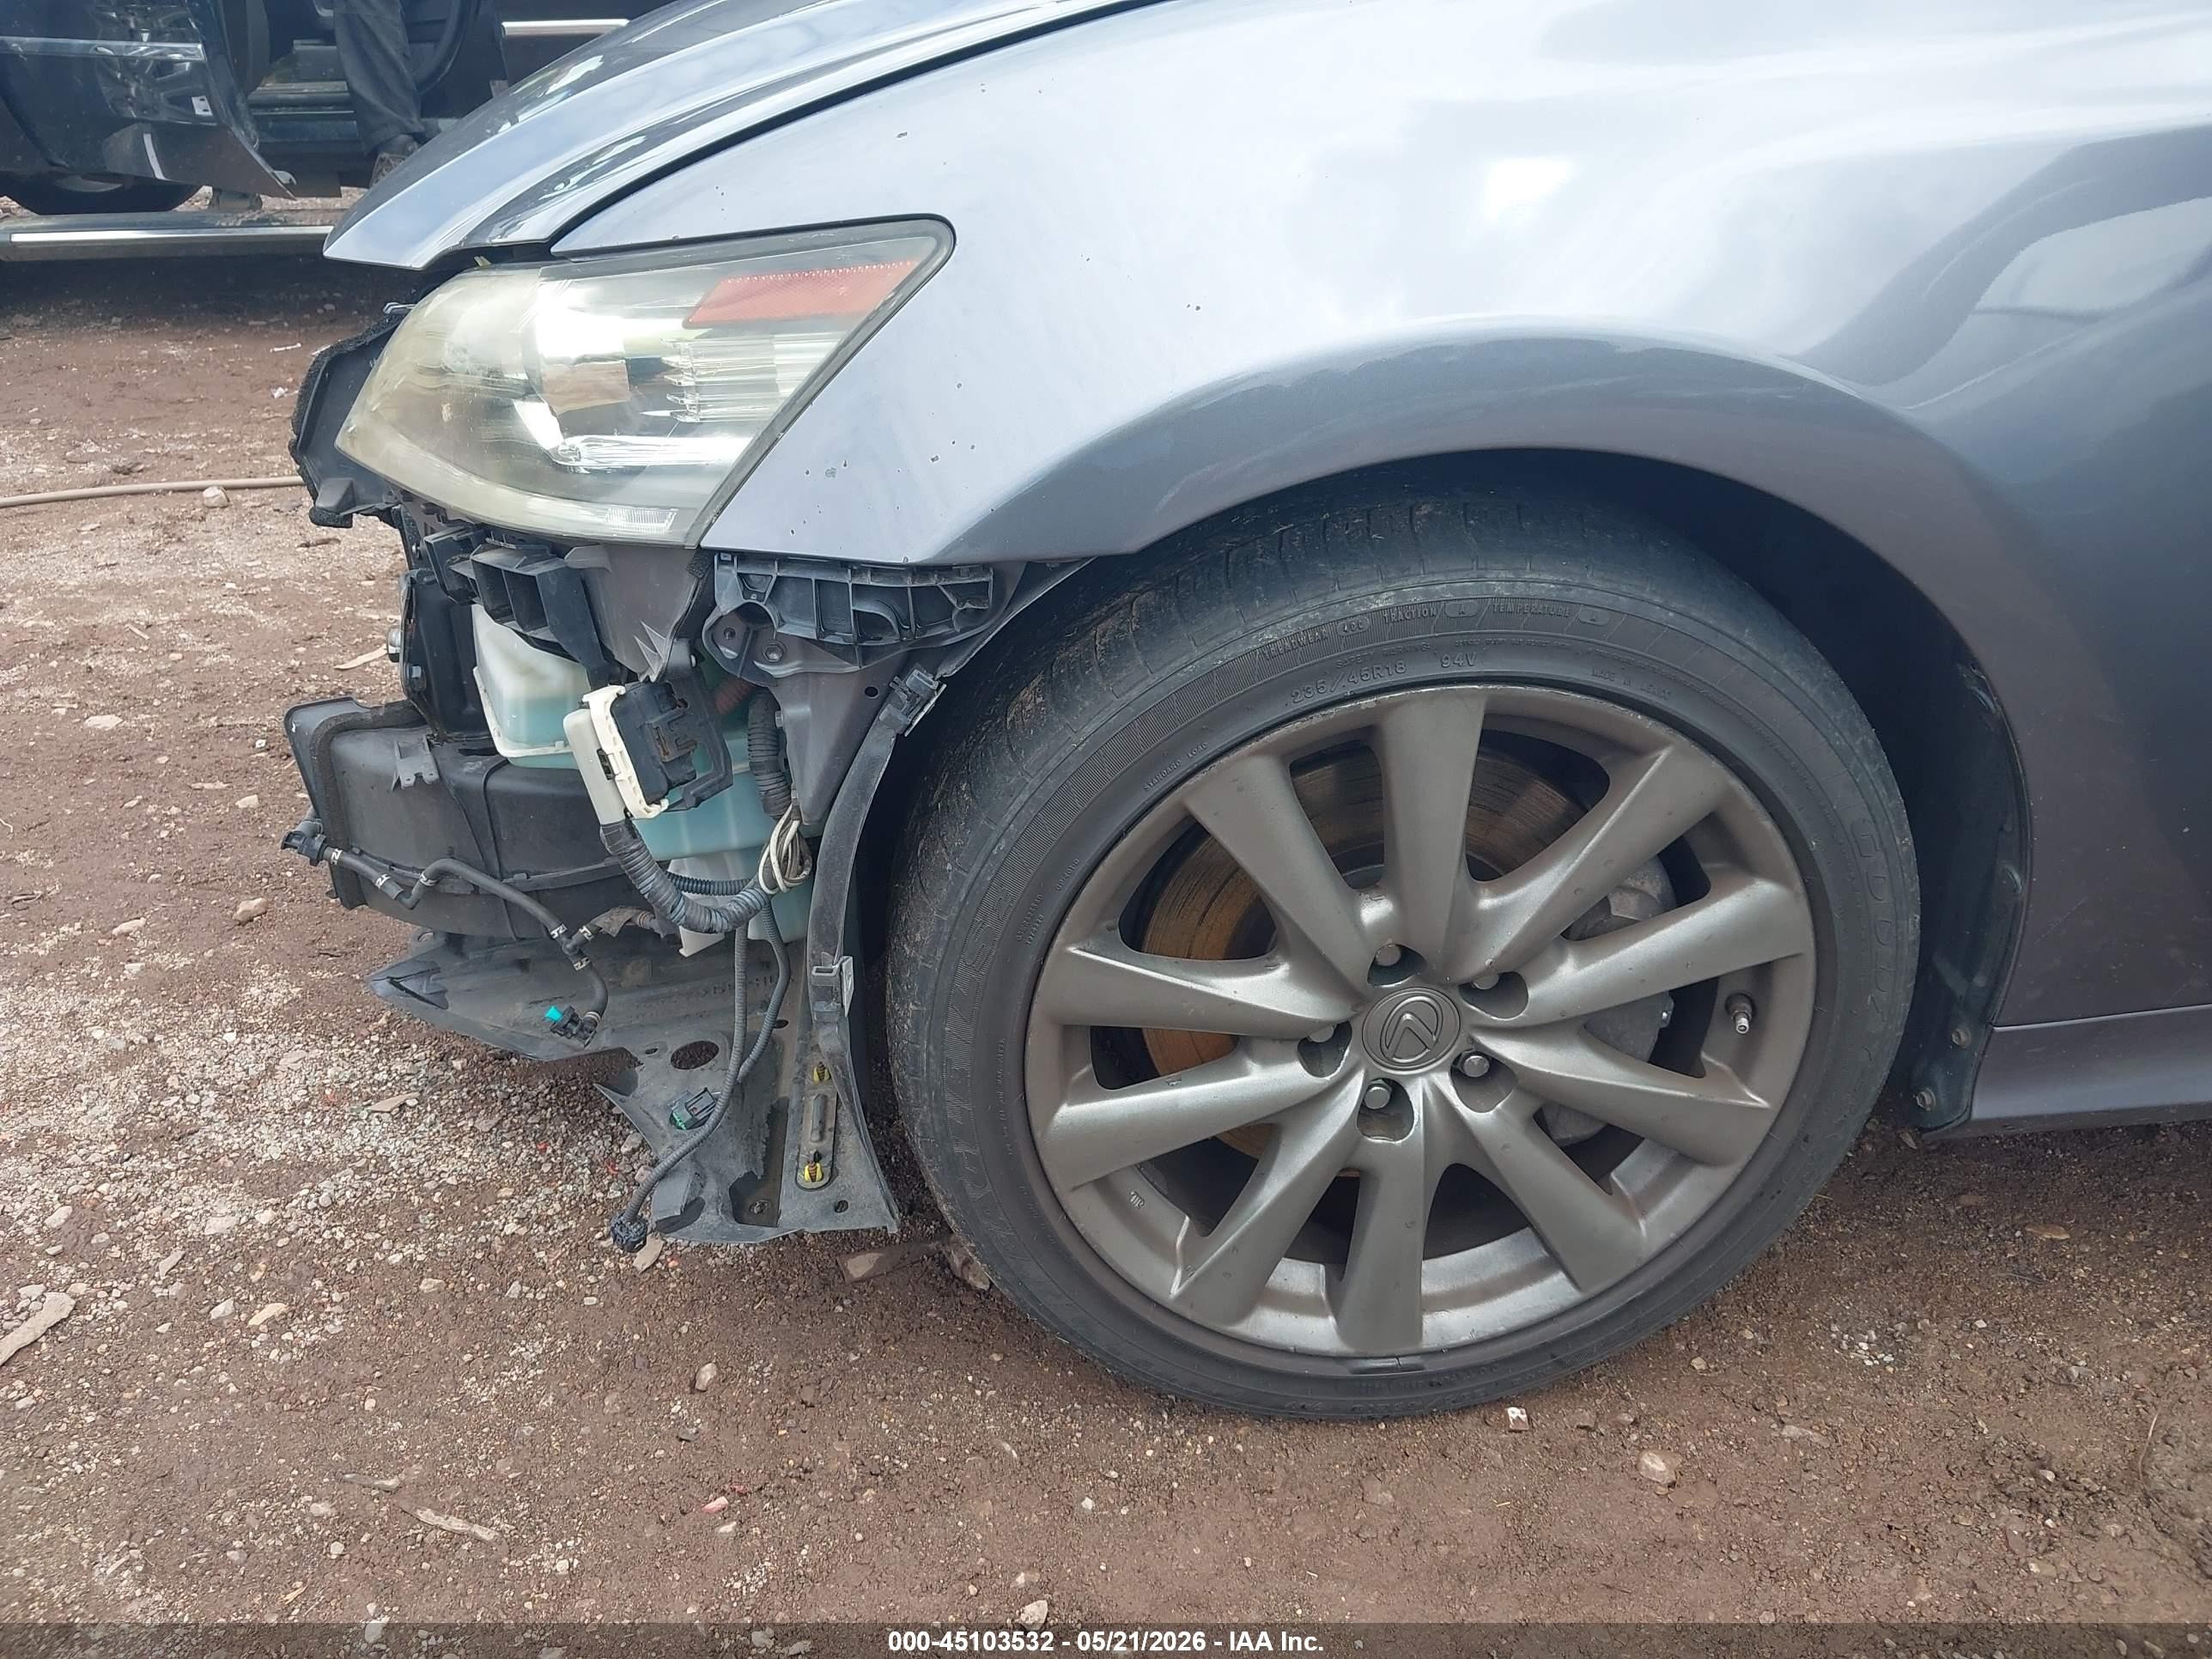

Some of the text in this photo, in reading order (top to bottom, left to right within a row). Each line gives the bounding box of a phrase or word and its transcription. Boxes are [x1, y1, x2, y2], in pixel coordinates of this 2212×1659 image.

[1382, 604, 1437, 625] TRACTION
[1492, 601, 1571, 618] TEMPERATURE
[1262, 626, 1329, 660] TREADWEAR
[1439, 651, 1478, 669] 94V
[1142, 759, 1182, 792] STANDARD
